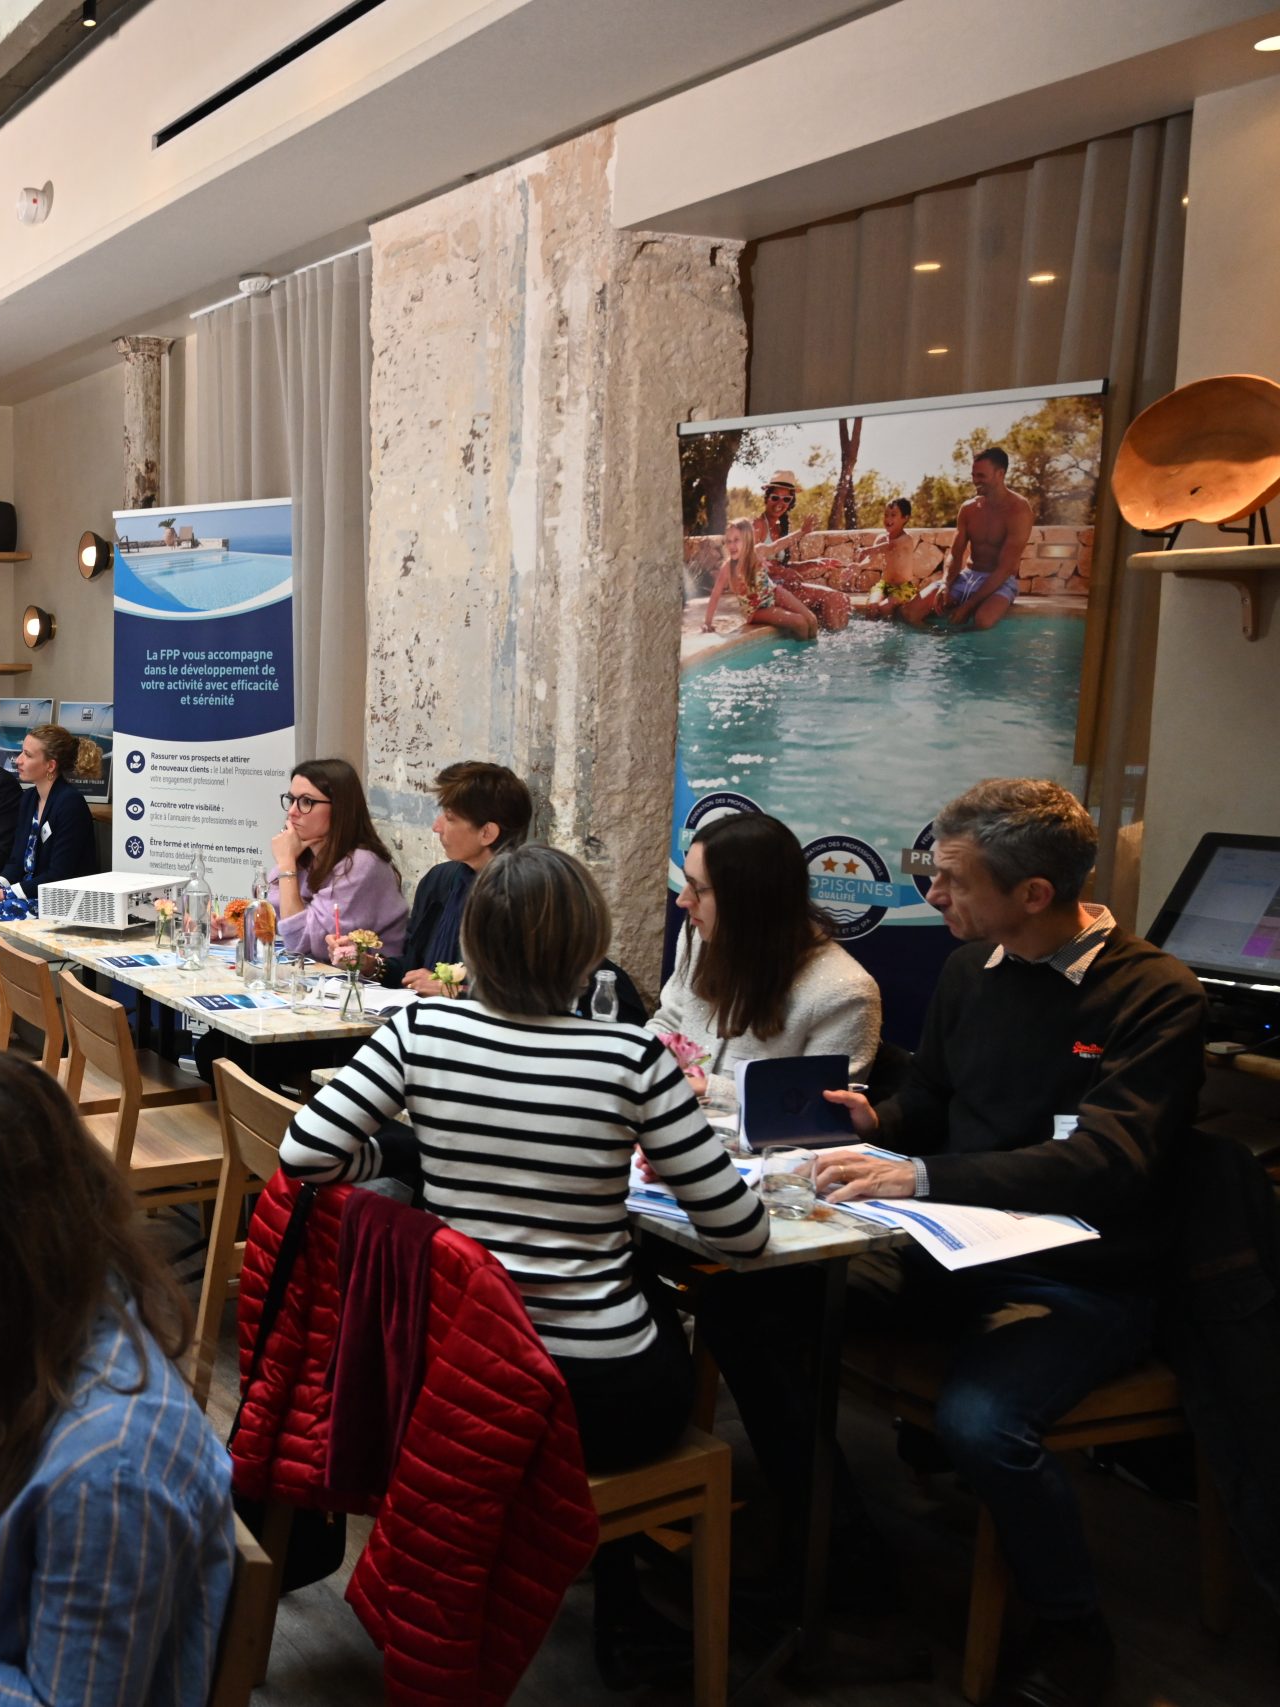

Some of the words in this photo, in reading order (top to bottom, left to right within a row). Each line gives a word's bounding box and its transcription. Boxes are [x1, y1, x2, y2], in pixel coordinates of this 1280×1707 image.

[146, 649, 158, 661] La
[160, 649, 181, 660] FPP
[182, 651, 206, 660] vous
[207, 651, 273, 662] accompagne
[144, 664, 167, 675] dans
[168, 664, 179, 675] le
[180, 663, 260, 677] développement
[261, 664, 276, 675] de
[140, 680, 165, 690] votre
[166, 678, 203, 690] activité
[205, 681, 228, 691] avec
[230, 678, 280, 691] efficacité
[180, 695, 191, 705] et
[192, 693, 235, 706] sérénité
[151, 752, 178, 760] Rassurer
[191, 753, 221, 763] prospects
[221, 755, 229, 763] et
[229, 755, 251, 764] attirer
[150, 763, 158, 771] de
[158, 764, 189, 772] nouveaux
[189, 765, 210, 774] clients
[213, 765, 220, 774] le
[220, 766, 234, 775] Label
[234, 767, 263, 777] Propiscines
[263, 767, 286, 777] valorise
[178, 802, 195, 810] votre
[195, 803, 221, 812] visibilité
[150, 836, 162, 846] Être
[163, 839, 182, 848] formé
[183, 840, 190, 849] et
[190, 841, 214, 851] informé
[215, 844, 224, 852] en
[224, 844, 245, 855] temps
[246, 845, 259, 855] réel
[809, 876, 894, 897] OPISCINES
[817, 890, 856, 902] QUALIFIÉ
